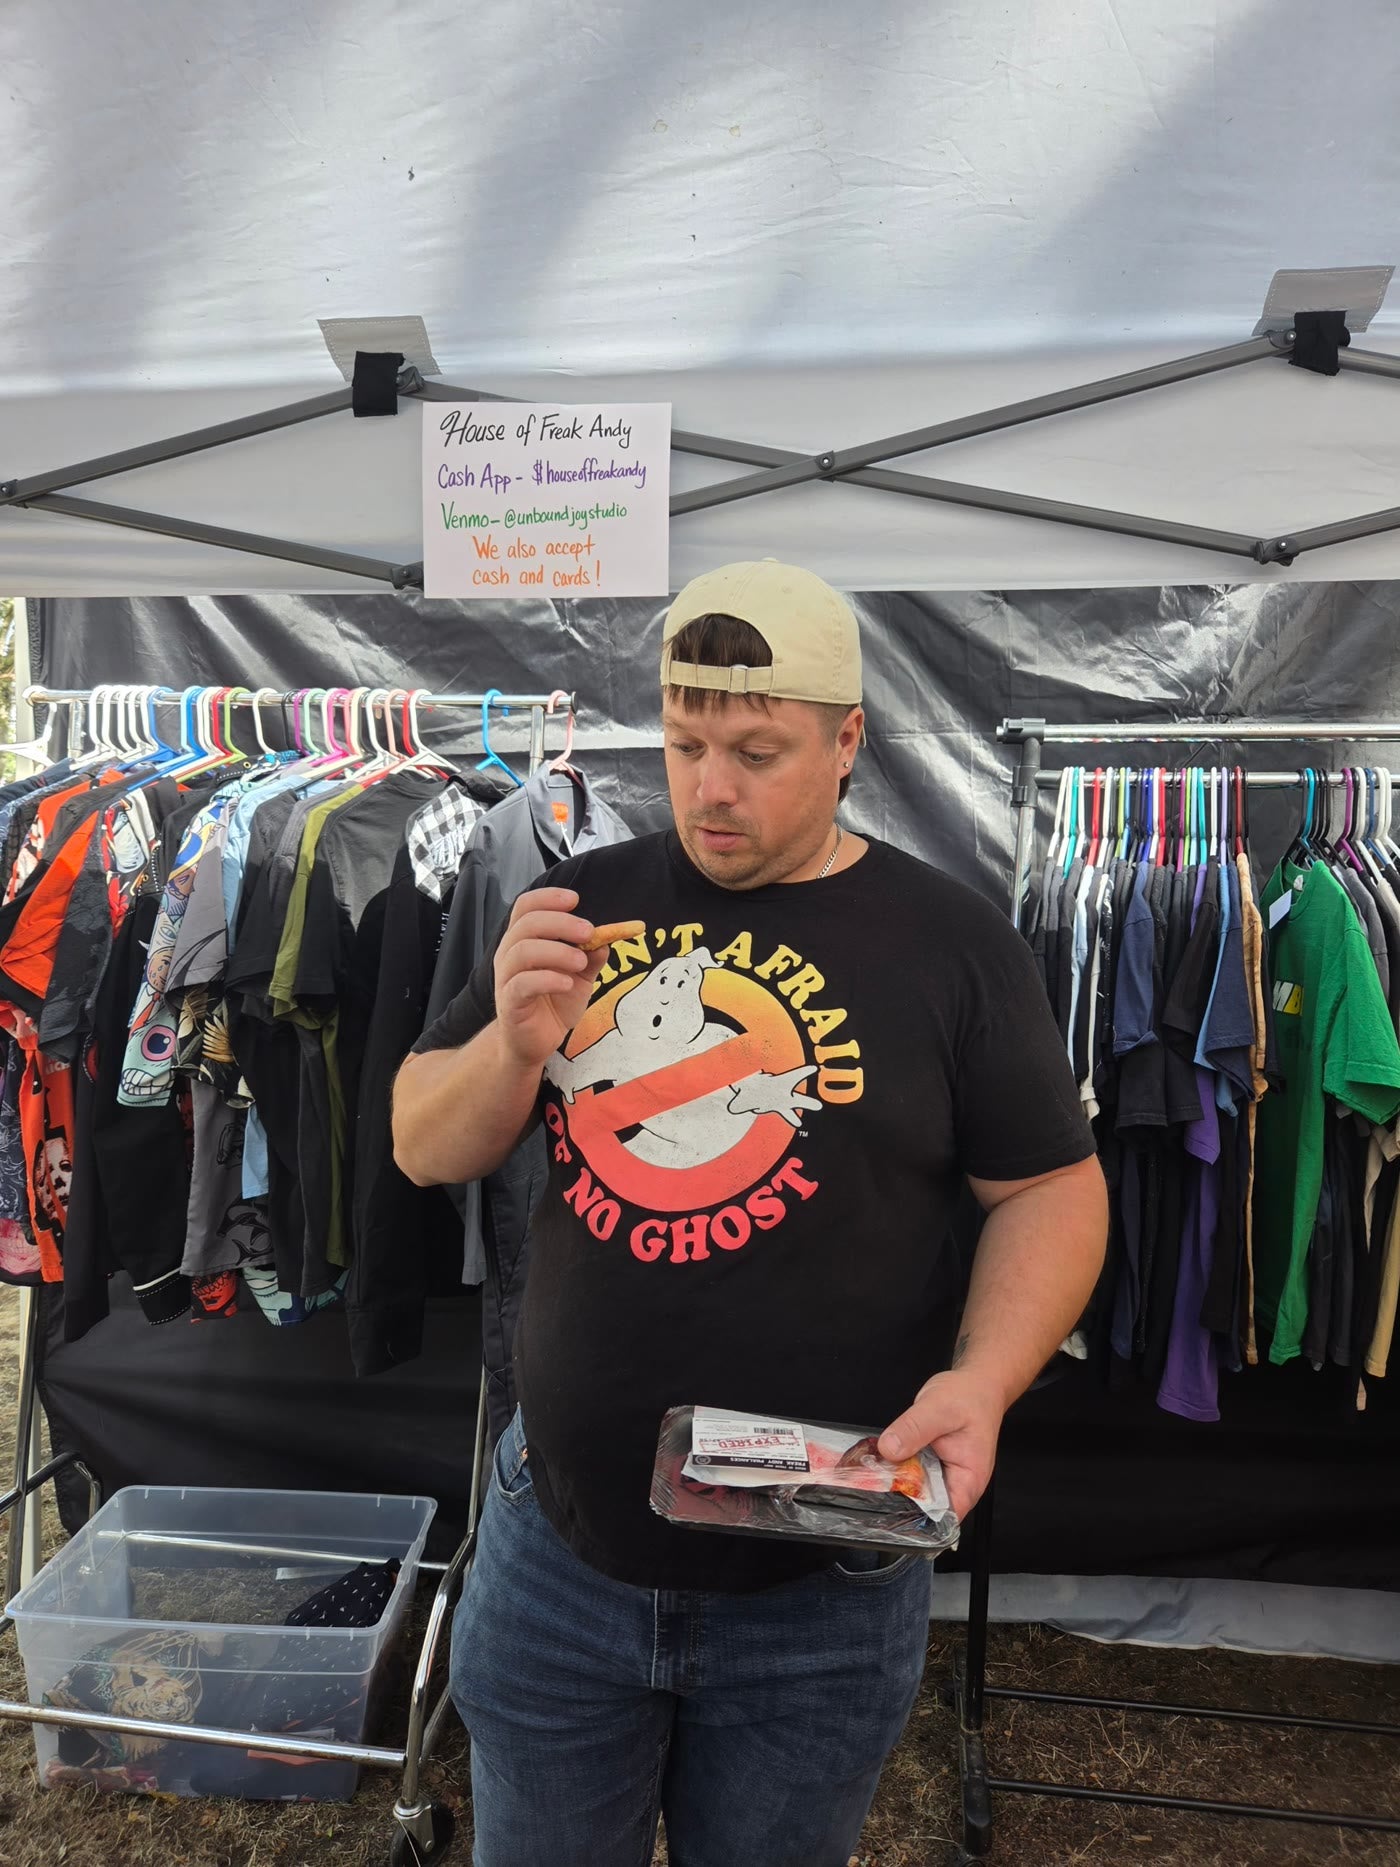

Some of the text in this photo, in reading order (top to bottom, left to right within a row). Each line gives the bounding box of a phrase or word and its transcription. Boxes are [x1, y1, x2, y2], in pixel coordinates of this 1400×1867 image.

[440, 411, 632, 449] House of Freak Andy
[438, 463, 474, 489] Cash
[472, 534, 596, 562] We also accept
[472, 566, 509, 585] cash
[519, 564, 544, 585] and
[563, 1167, 621, 1241] NO
[630, 1157, 819, 1264] GHOST
[719, 1436, 780, 1448] EXPIRED
